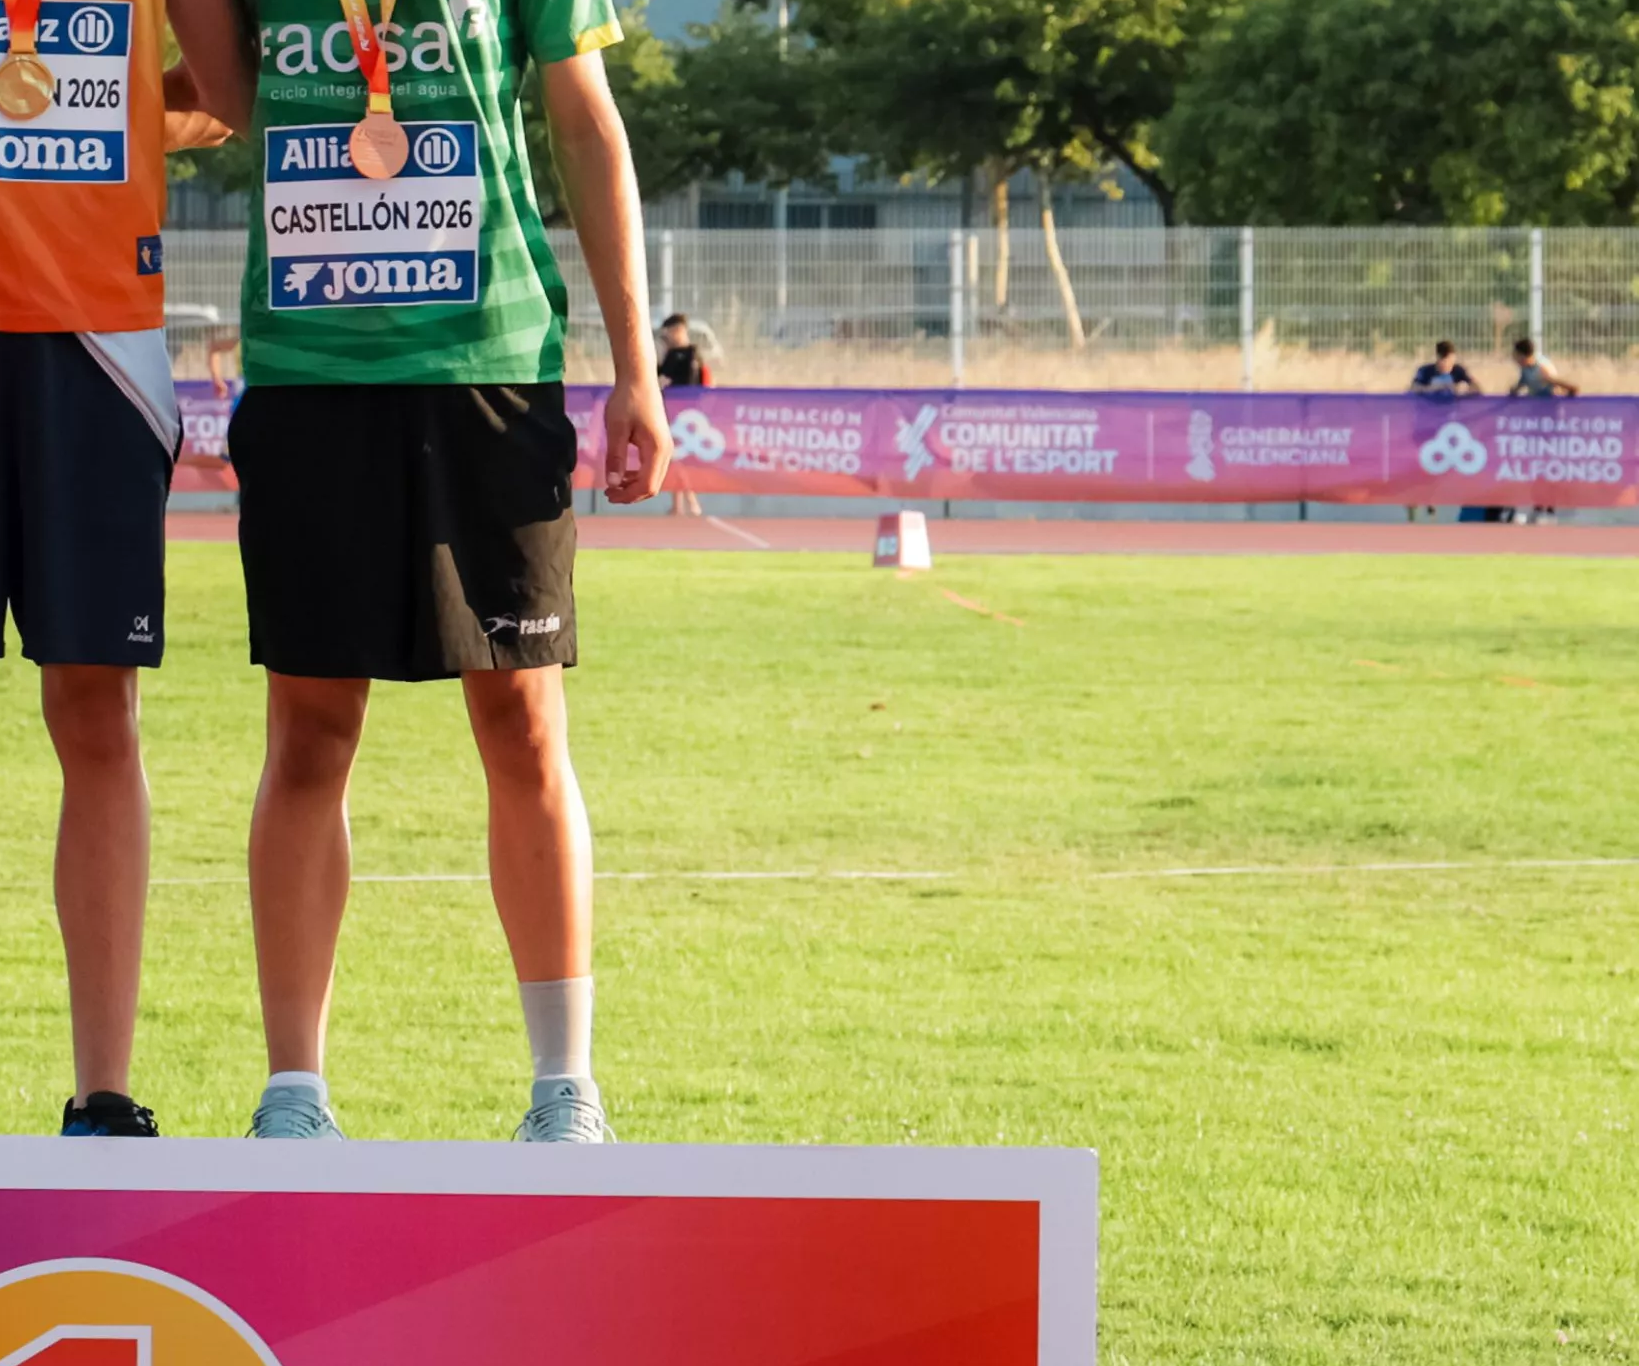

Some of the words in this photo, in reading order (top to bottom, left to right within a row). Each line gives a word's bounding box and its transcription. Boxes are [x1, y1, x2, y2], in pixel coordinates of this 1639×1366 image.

[68, 79, 120, 108] 2026
[314, 83, 368, 99] integr
[281, 136, 352, 170] Allia
[271, 193, 409, 235] CASTELLÓN
[416, 200, 473, 230] 2026
[735, 423, 862, 452] TRINIDAD
[940, 422, 1099, 448] COMUNITAT
[1495, 434, 1624, 460] TRINIDAD
[734, 449, 862, 475] ALFONSO
[951, 448, 988, 473] DE
[993, 448, 1119, 475] L'ESPORT
[1222, 447, 1351, 466] VALENCIANA
[1495, 459, 1623, 483] ALFONSO
